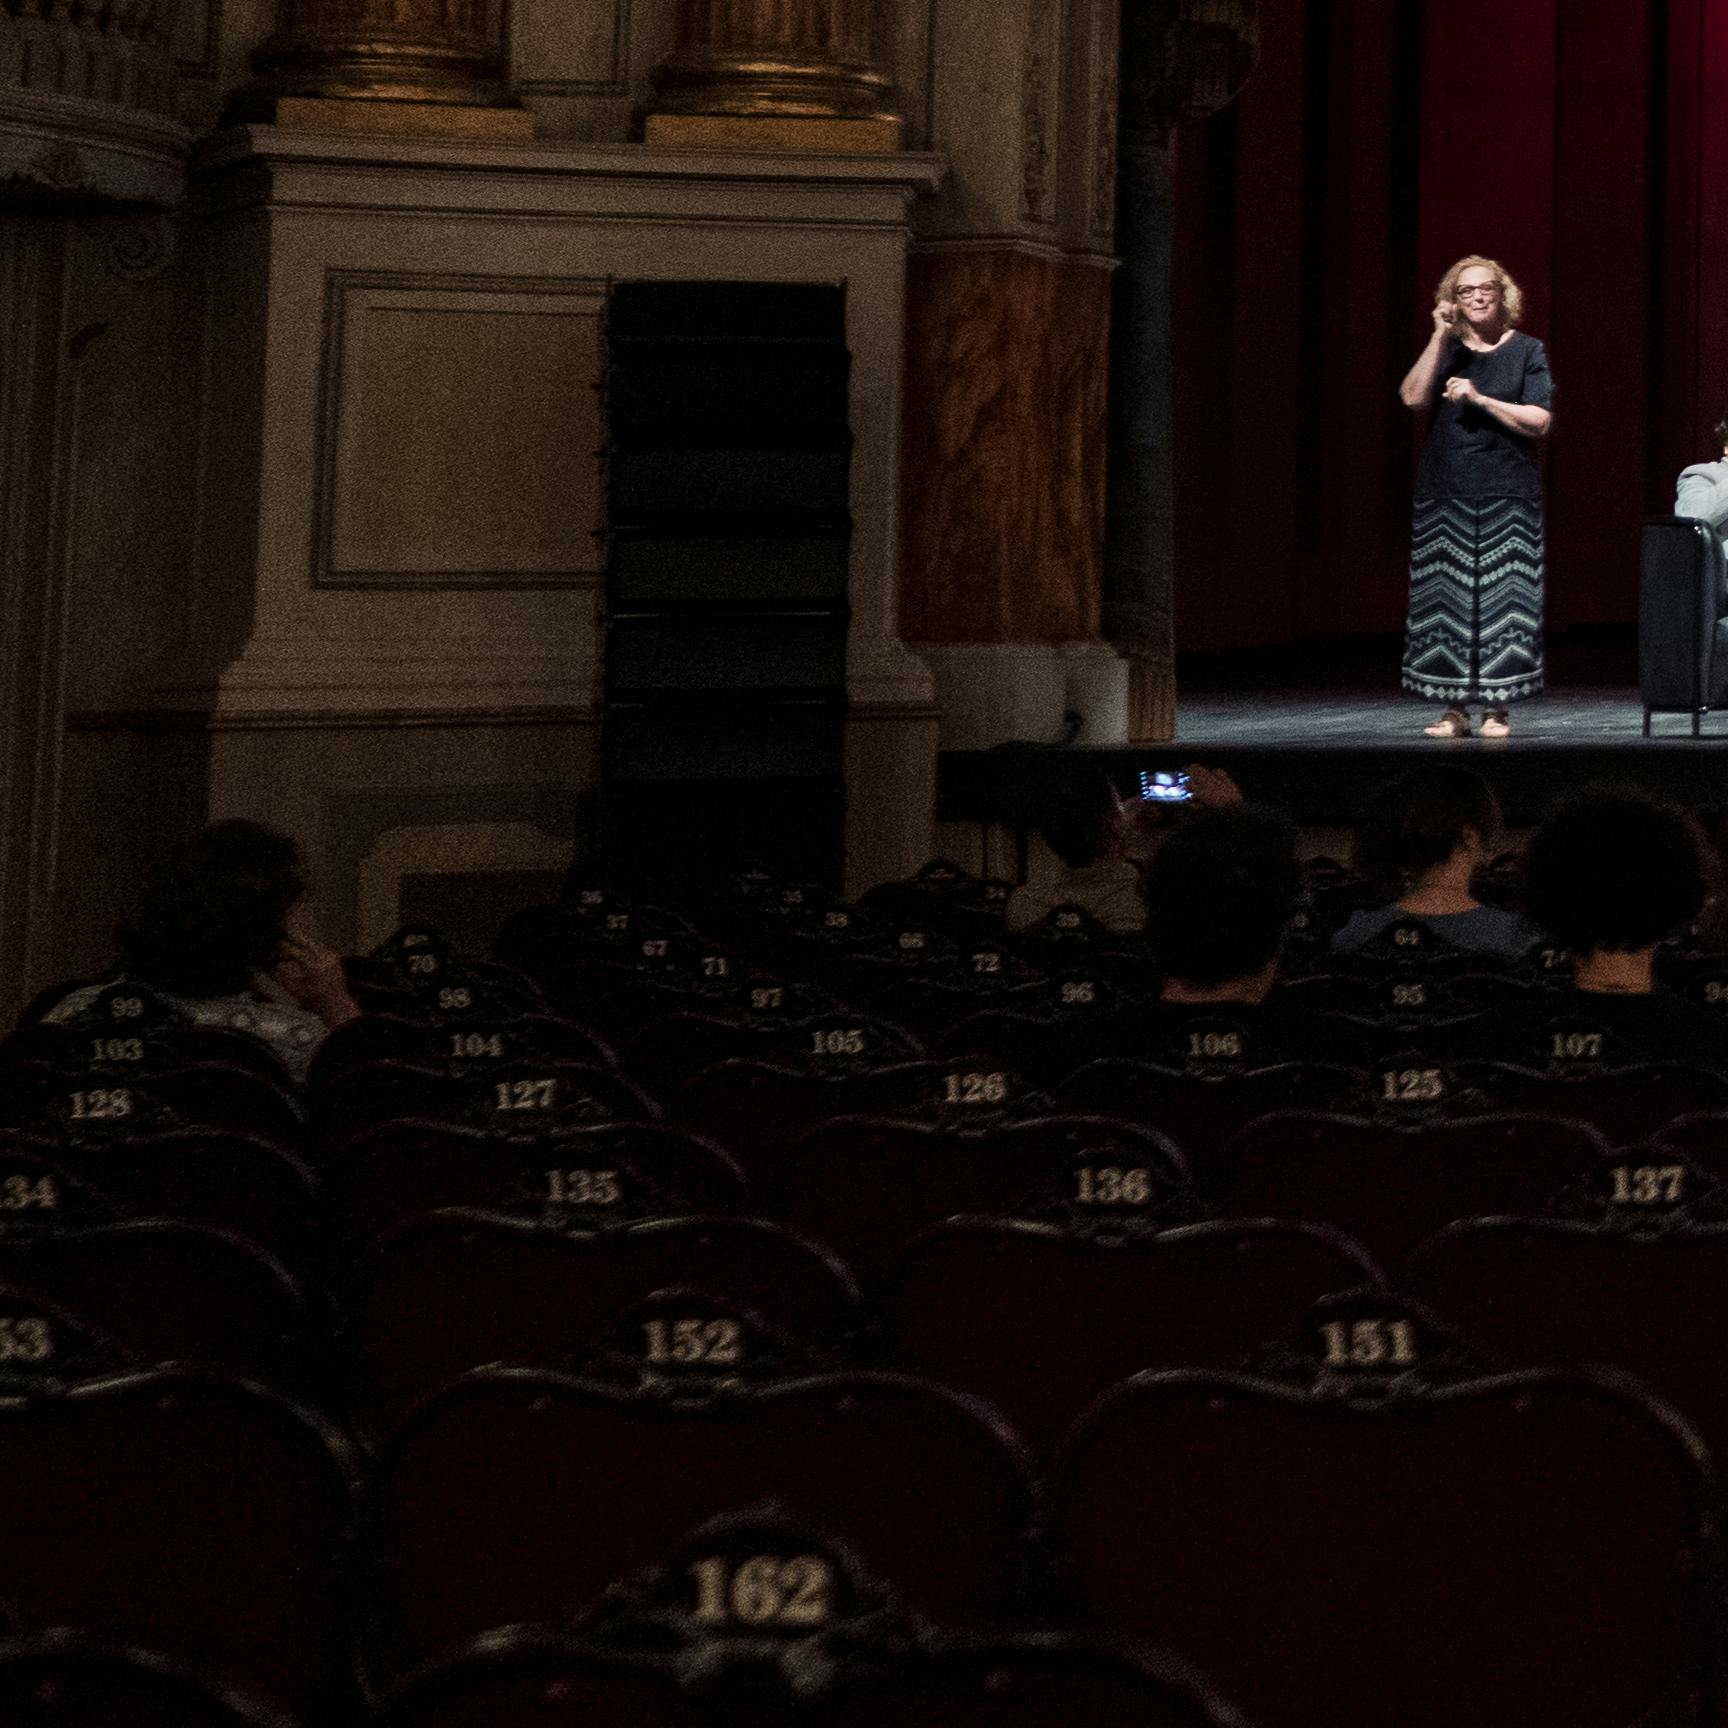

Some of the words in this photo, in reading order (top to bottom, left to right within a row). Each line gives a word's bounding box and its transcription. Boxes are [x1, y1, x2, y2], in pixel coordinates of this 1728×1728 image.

[111, 996, 144, 1018] 99
[93, 1037, 144, 1061] 103
[451, 1033, 503, 1057] 104
[812, 1029, 865, 1055] 105
[1189, 1033, 1241, 1057] 106
[1552, 1033, 1602, 1057] 107
[496, 1078, 557, 1110] 127
[945, 1072, 1007, 1103] 126
[1383, 1069, 1444, 1101] 125
[547, 1169, 620, 1204] 135
[1077, 1168, 1151, 1204] 136
[1612, 1165, 1684, 1203] 137
[645, 1319, 740, 1363] 152
[1323, 1320, 1414, 1365] 151
[689, 1557, 829, 1624] 162
